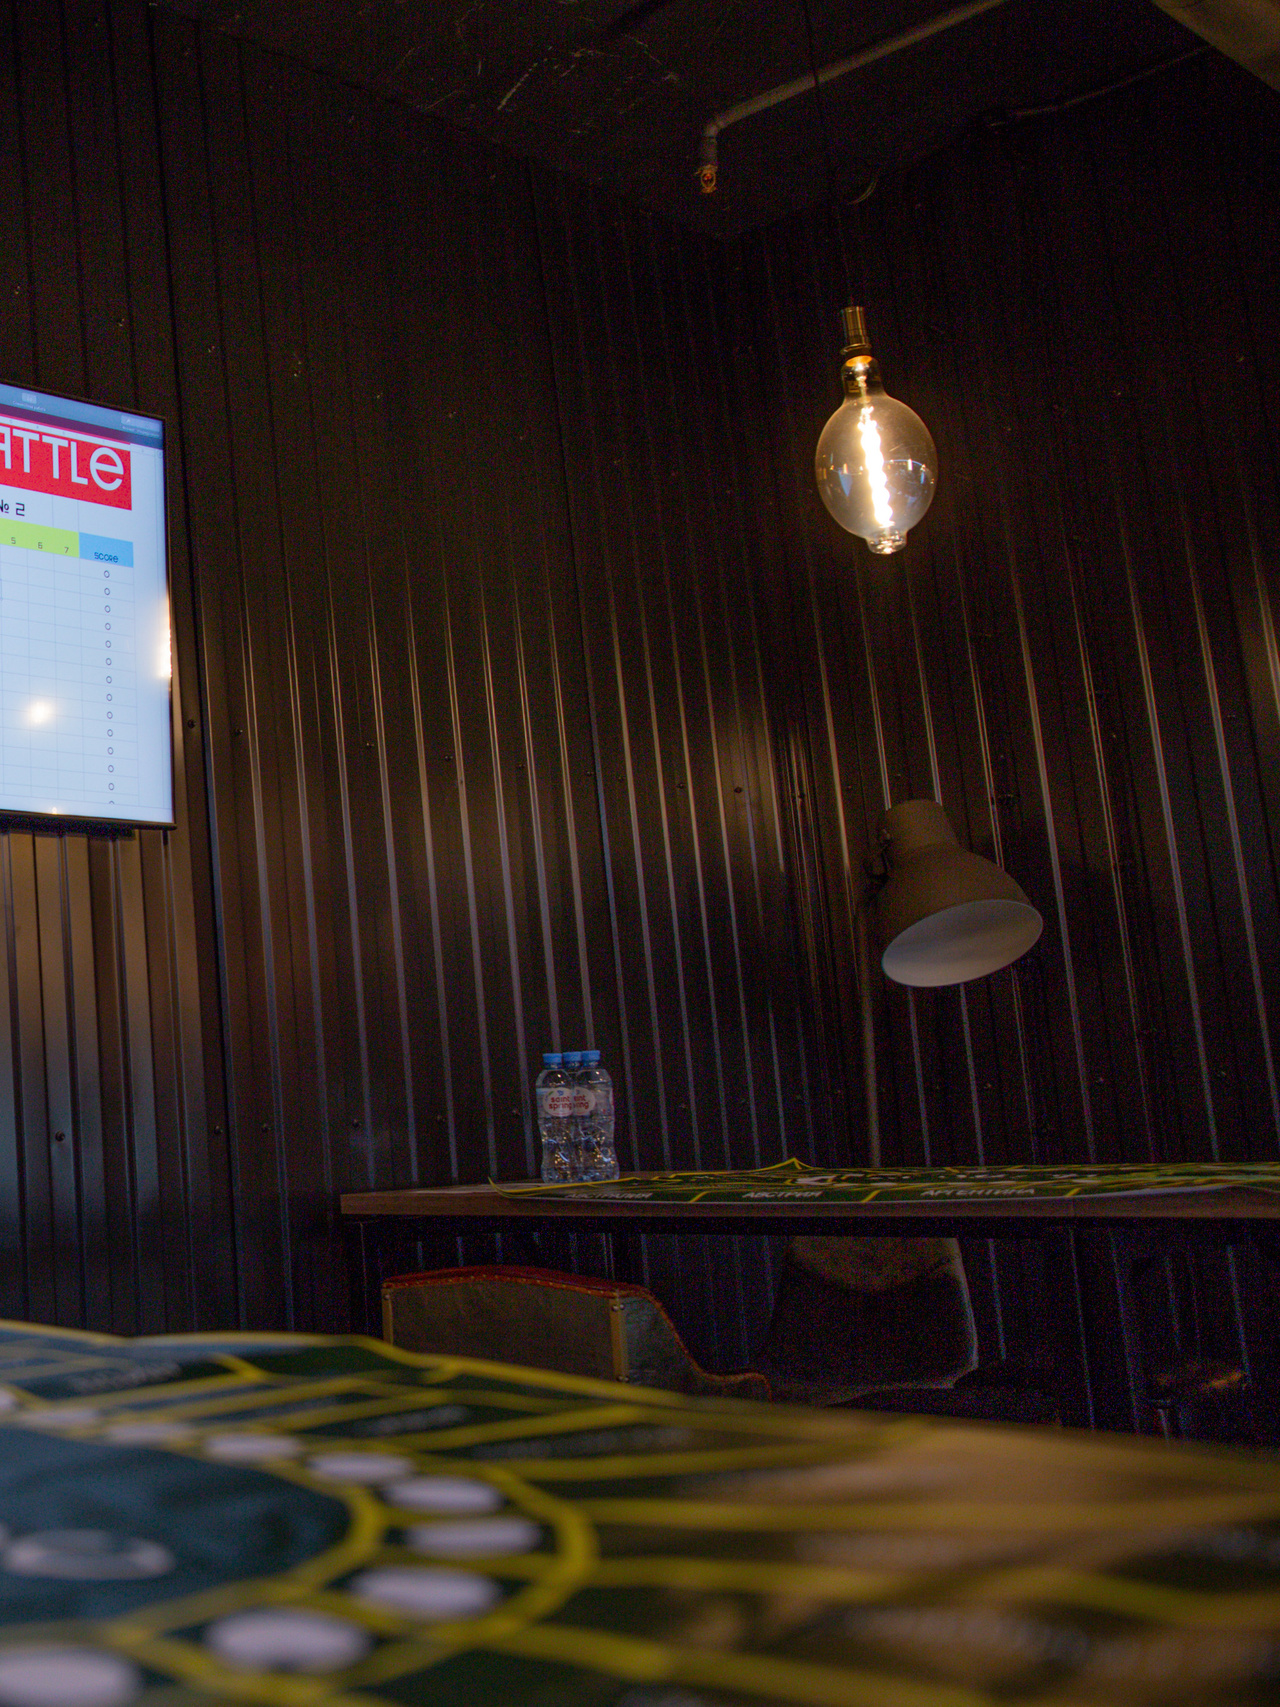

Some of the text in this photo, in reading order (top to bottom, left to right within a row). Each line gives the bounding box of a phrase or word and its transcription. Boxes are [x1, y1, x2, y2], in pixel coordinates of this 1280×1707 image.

[15, 502, 26, 517] 2
[10, 537, 16, 545] 5
[37, 542, 43, 550] 6
[64, 546, 70, 554] 7
